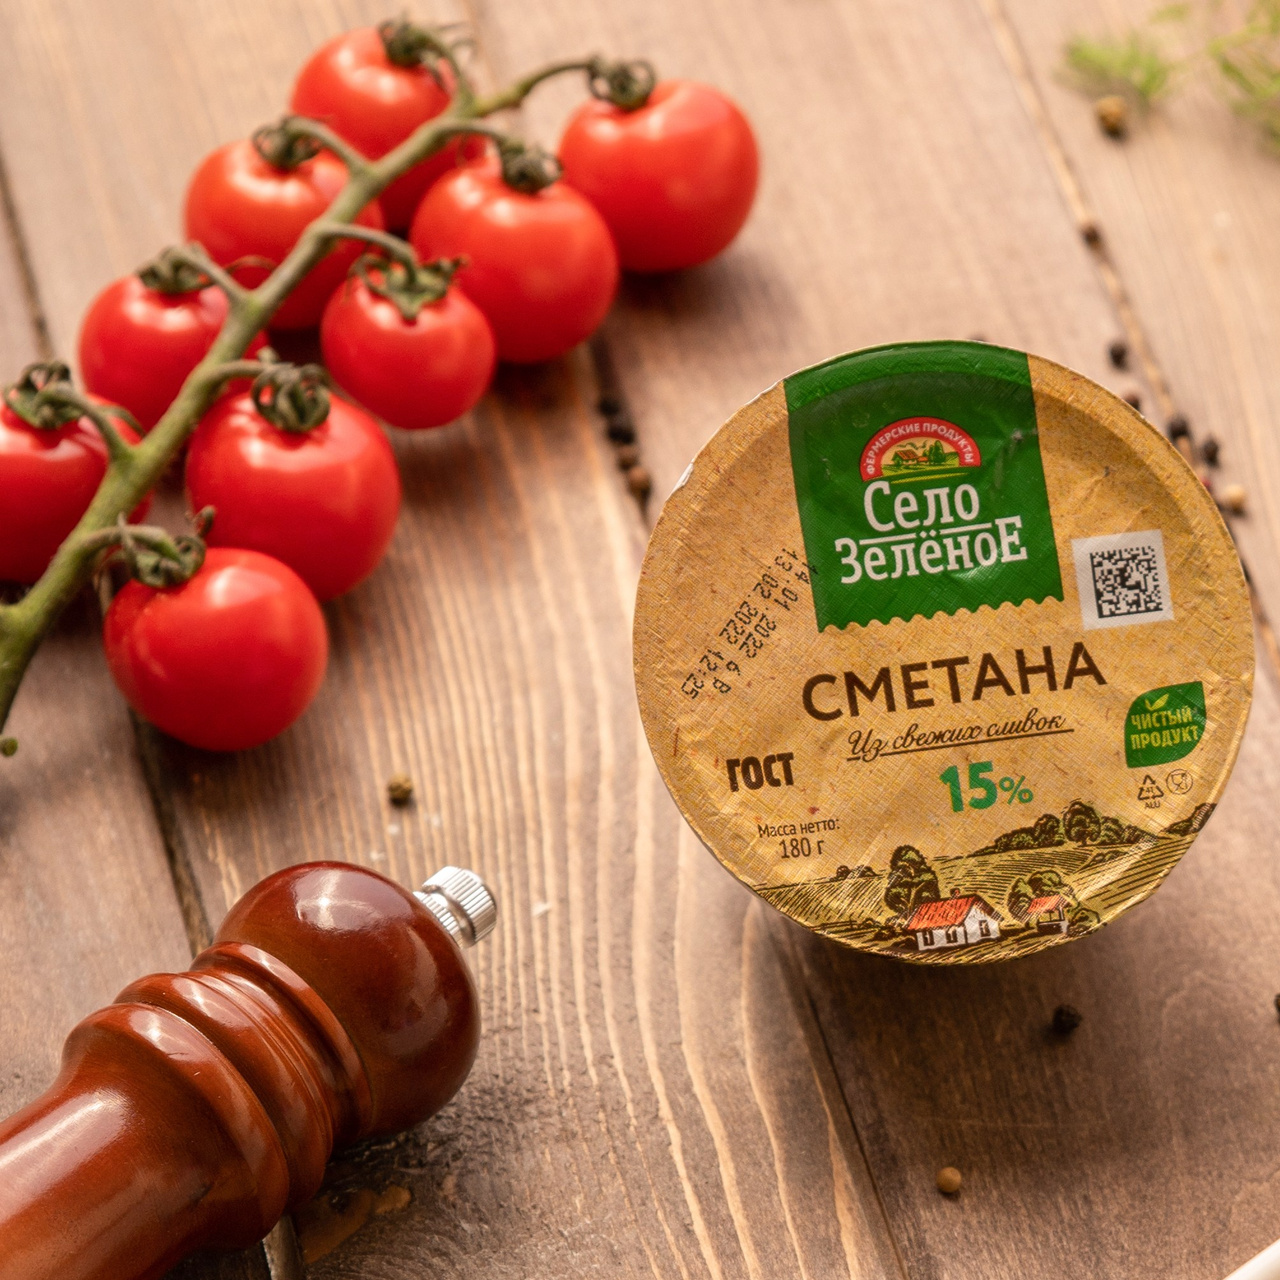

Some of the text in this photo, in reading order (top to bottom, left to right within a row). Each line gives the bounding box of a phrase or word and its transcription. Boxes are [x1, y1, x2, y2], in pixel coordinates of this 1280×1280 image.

[866, 422, 974, 475] ФЕРМЕРСКИЕ ПРОДУКТЫ
[863, 480, 980, 532] Село
[680, 547, 799, 699] 13.02.2022 12:25
[802, 641, 1107, 721] СМЕТАНА
[848, 707, 1067, 762] Из свежих сливок
[1130, 705, 1193, 730] ЧИСТЫЙ
[1130, 725, 1199, 750] ПРОДУКТ
[726, 752, 794, 792] ГОСТ
[938, 760, 1034, 813] 15%
[757, 818, 841, 838] Масса нетто:
[779, 837, 825, 859] 180 г
